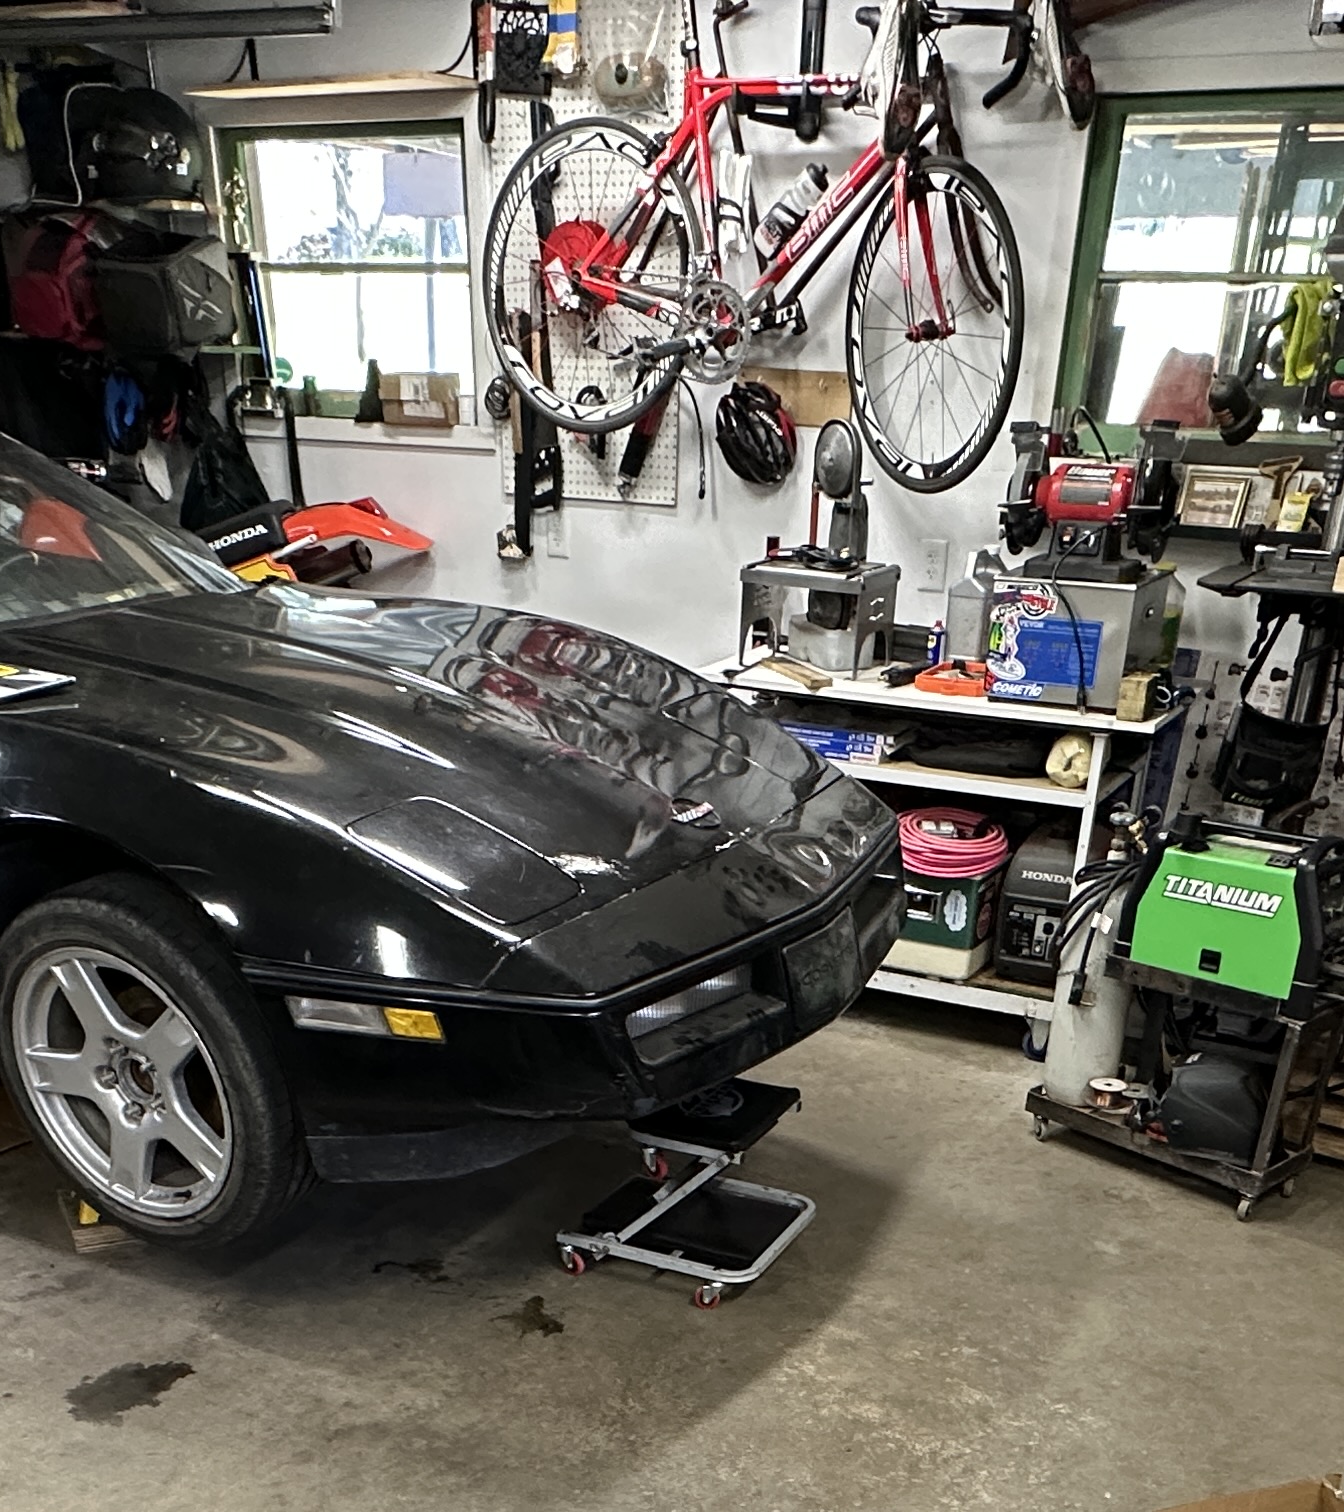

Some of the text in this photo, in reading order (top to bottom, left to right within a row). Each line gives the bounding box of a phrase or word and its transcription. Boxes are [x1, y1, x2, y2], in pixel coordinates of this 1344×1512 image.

[208, 523, 269, 551] HONDA
[1021, 869, 1073, 885] HONDA
[1165, 874, 1283, 914] TITANIUM
